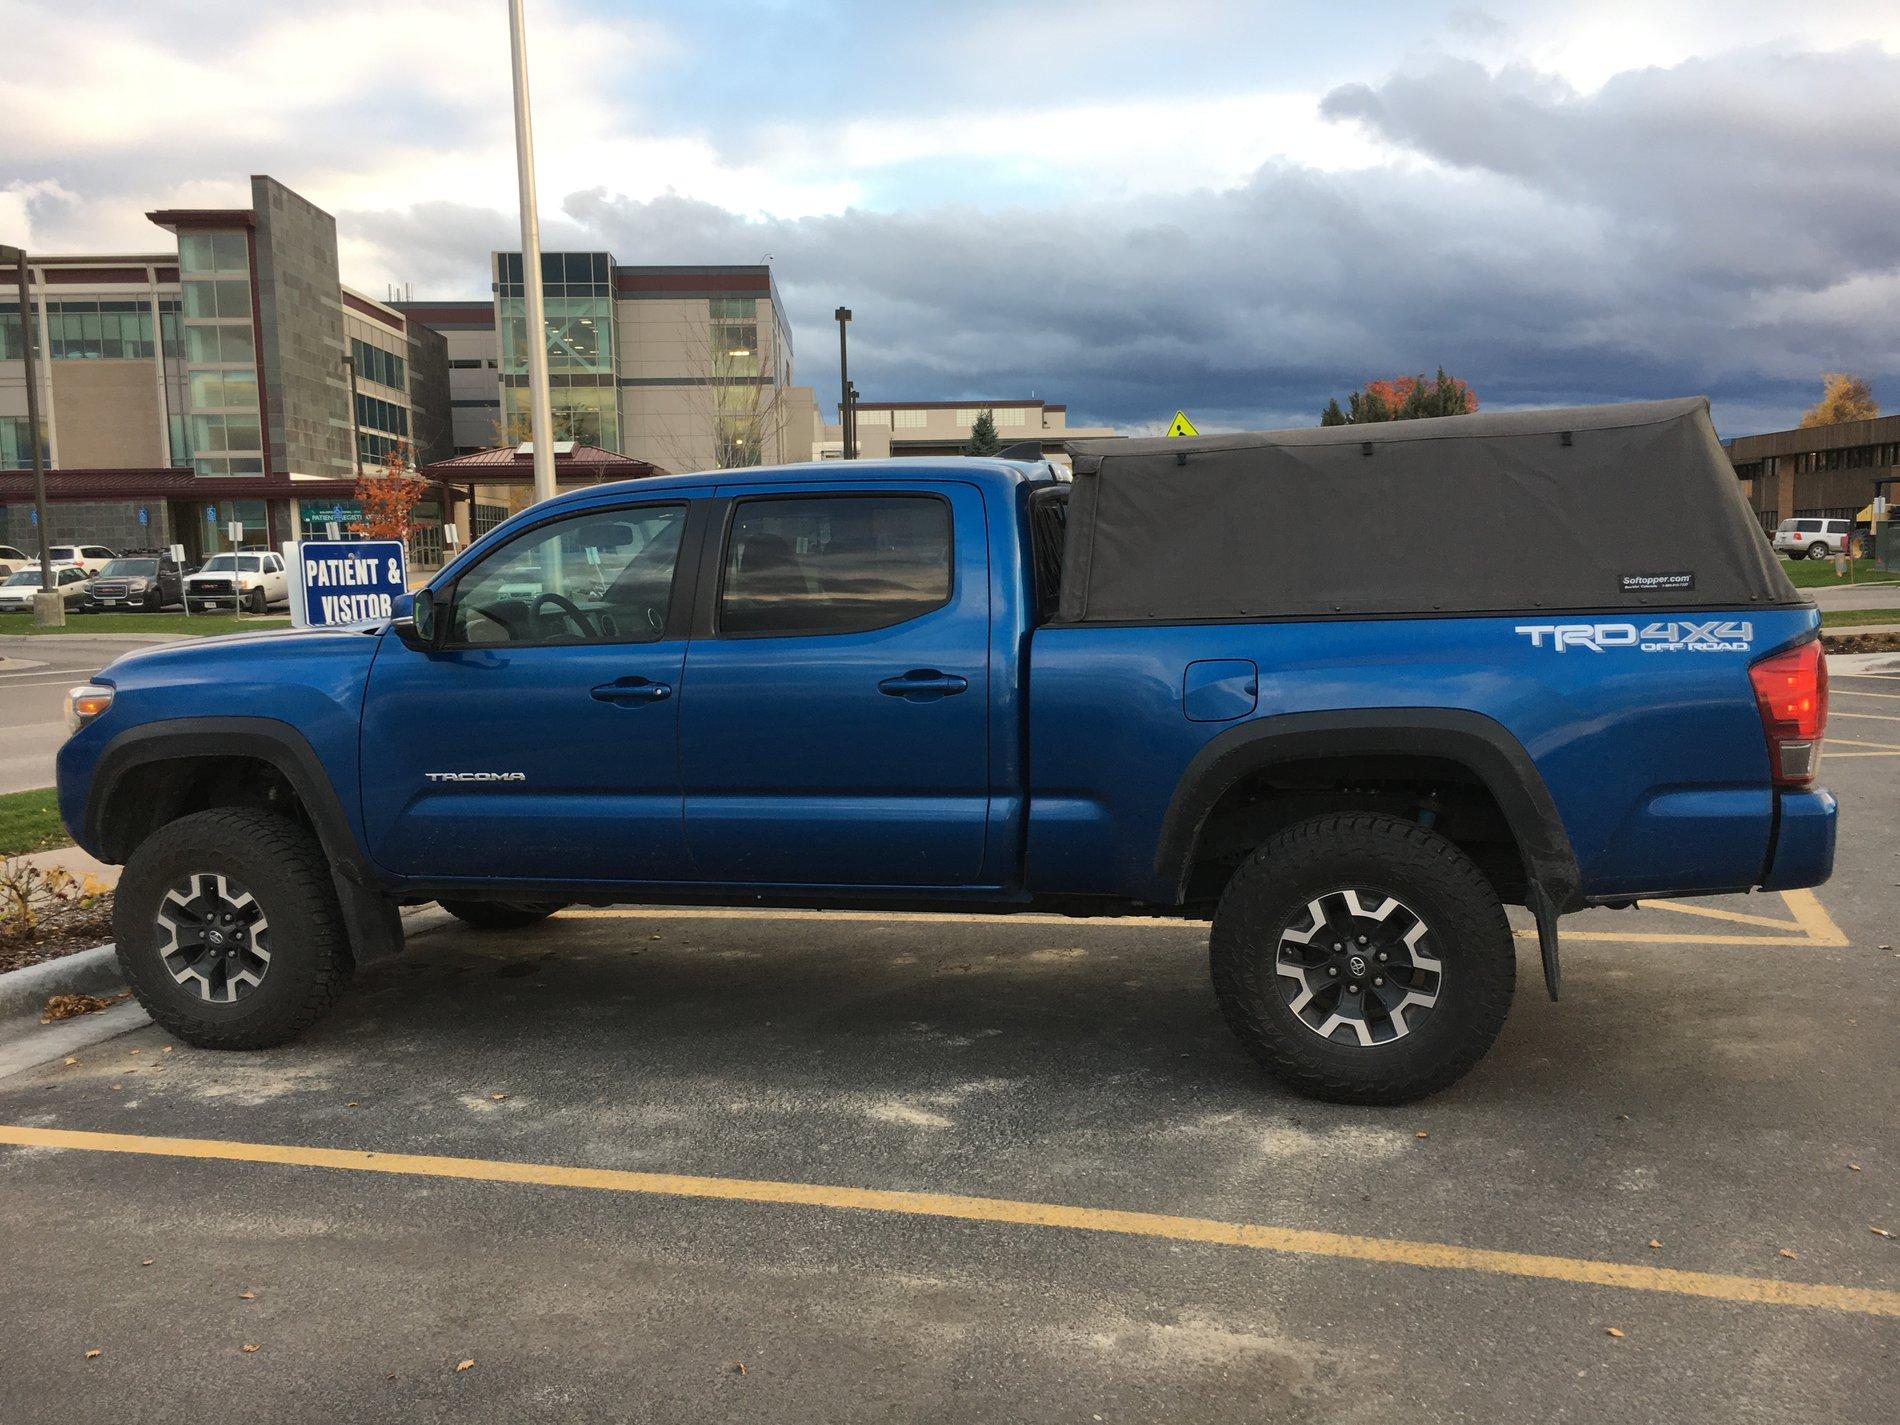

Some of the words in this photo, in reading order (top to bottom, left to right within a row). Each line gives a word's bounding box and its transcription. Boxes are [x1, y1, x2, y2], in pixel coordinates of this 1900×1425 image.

[306, 558, 378, 587] PATIENT
[387, 557, 401, 584] &
[1623, 575, 1690, 585] Softopper.com
[321, 593, 392, 625] VISITOR
[1515, 623, 1639, 653] TRD
[1641, 642, 1684, 652] OFF
[1687, 642, 1750, 652] ROAD
[425, 772, 526, 781] TACOMA
